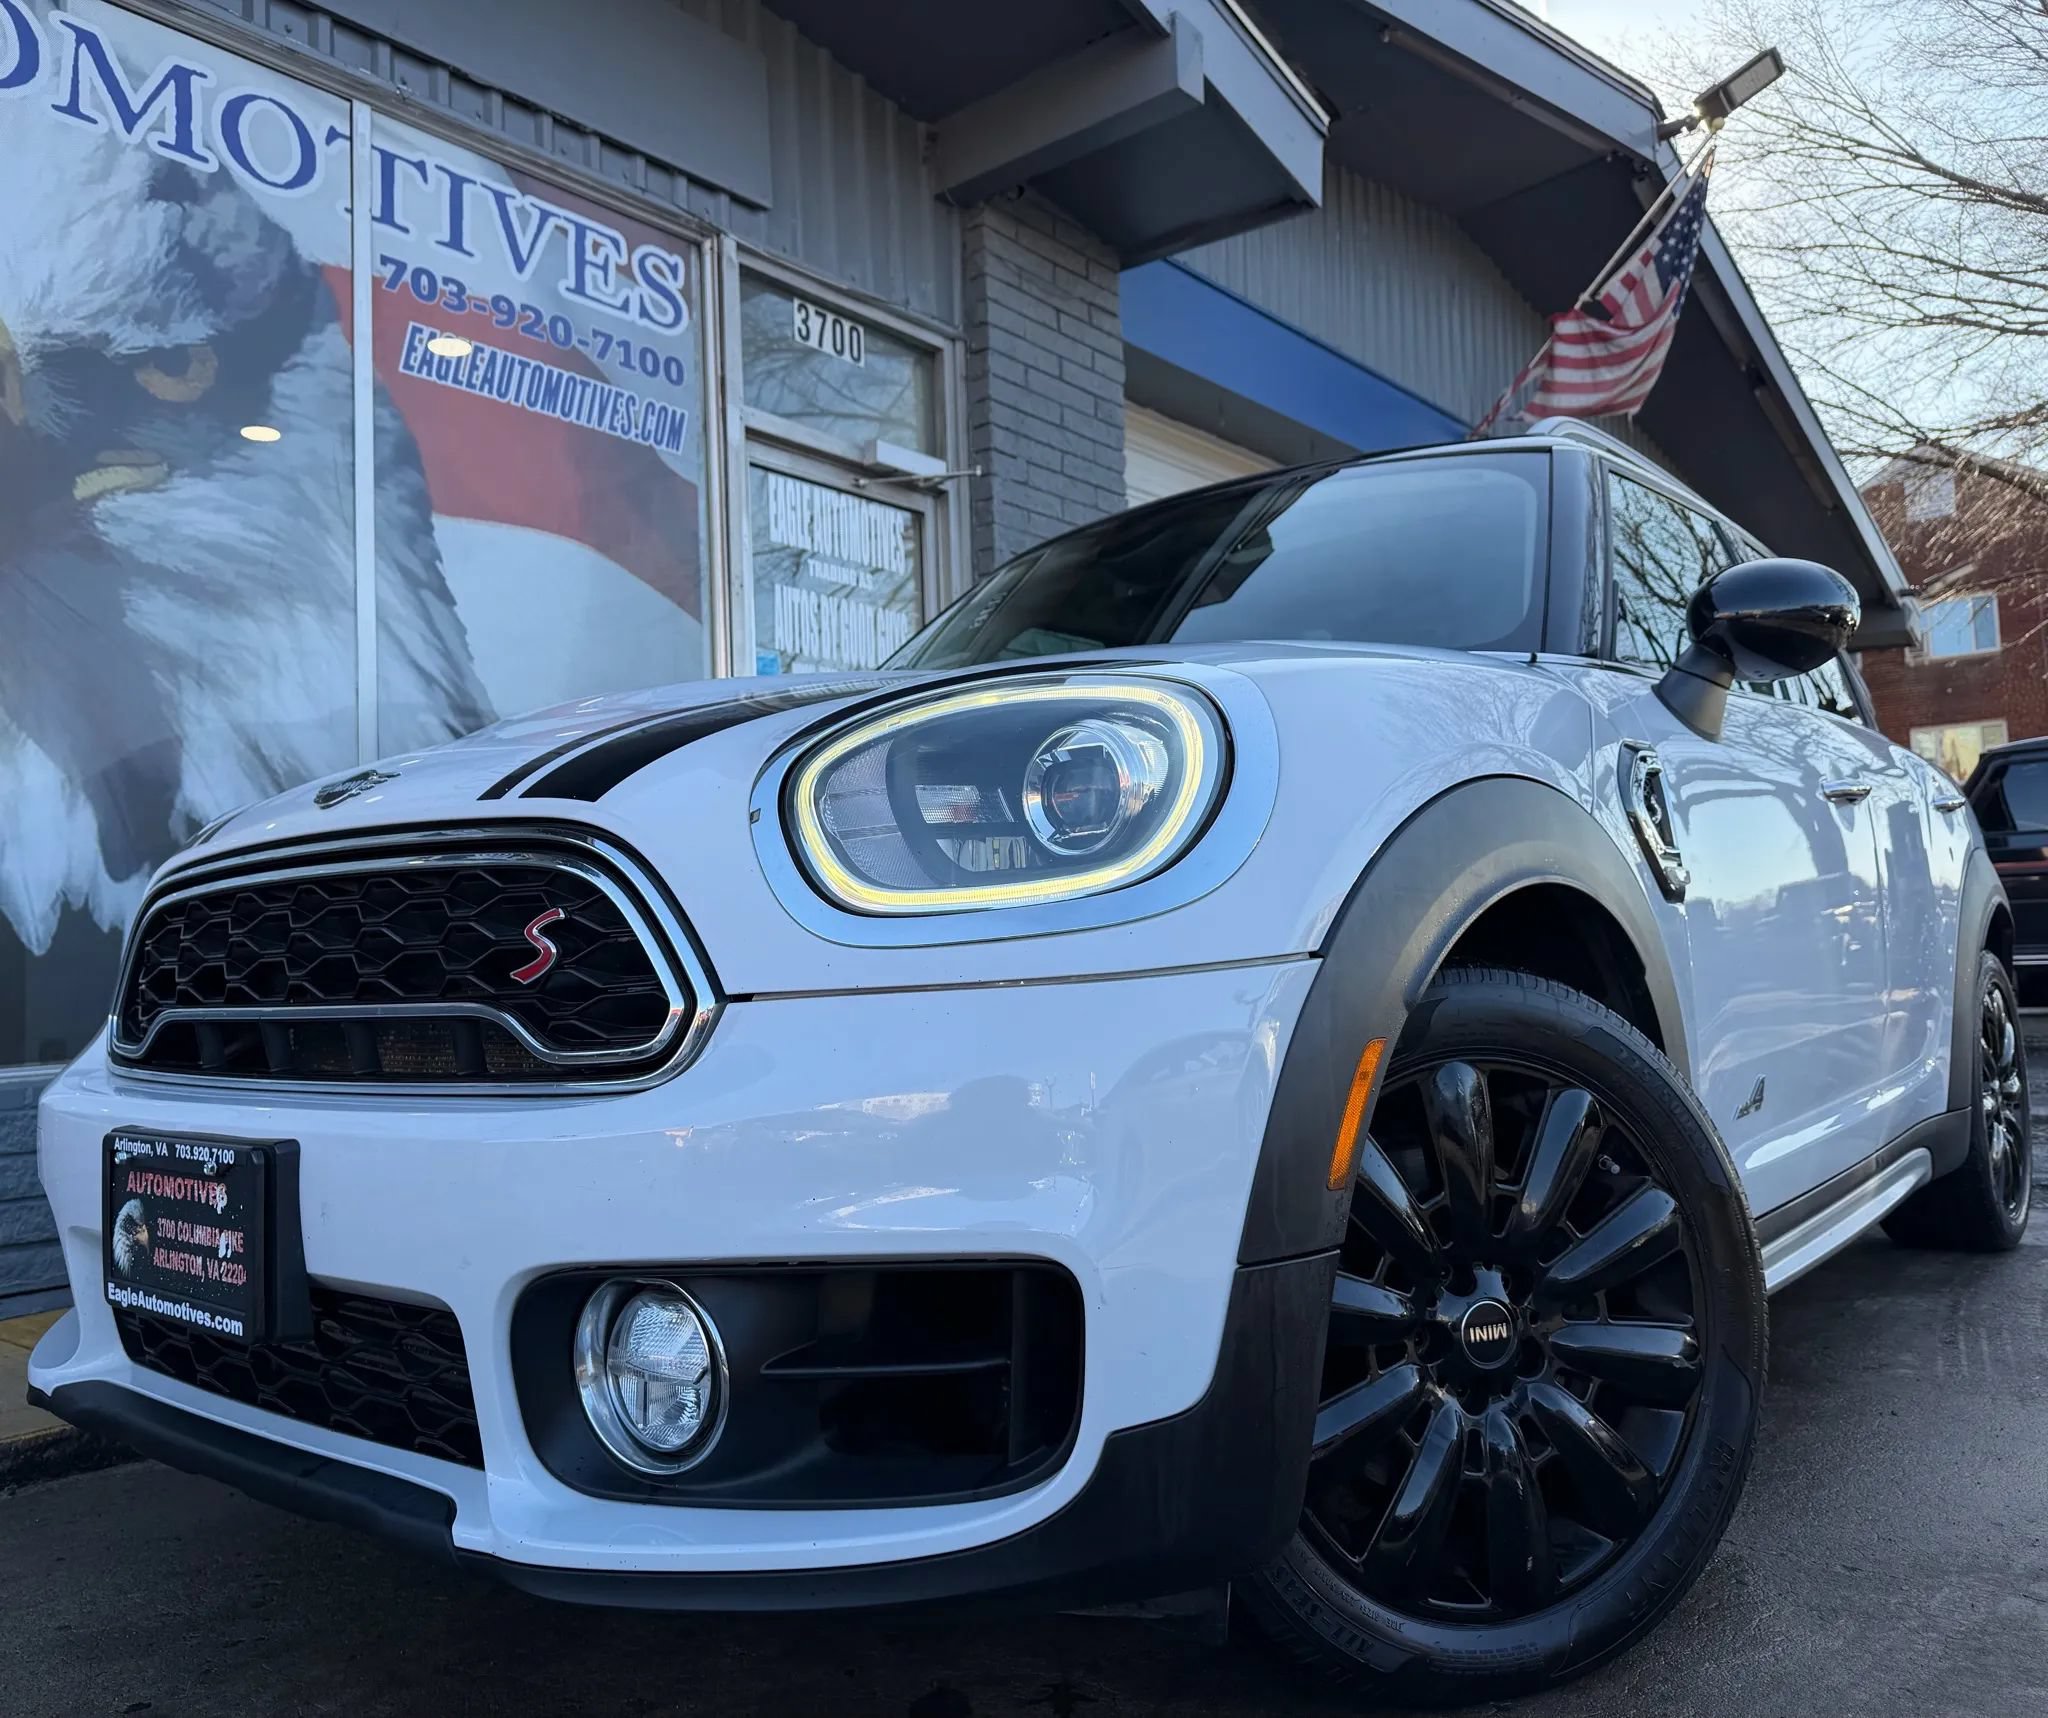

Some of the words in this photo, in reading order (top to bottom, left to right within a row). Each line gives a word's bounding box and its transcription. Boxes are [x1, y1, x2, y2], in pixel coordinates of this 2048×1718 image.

[379, 254, 685, 387] 703-920-7100
[797, 302, 861, 364] 3700
[400, 322, 687, 453] EAGLEAUTOMOTIVES.COM
[813, 487, 905, 576] AUTOMOTIVES
[775, 583, 819, 659] AUTOS
[510, 907, 565, 984] S
[113, 1137, 153, 1156] Arlington,
[155, 1142, 168, 1157] VA
[175, 1144, 235, 1165] 703.920.7100
[157, 1217, 176, 1240] 3700
[177, 1221, 220, 1248] COLUMBIA
[207, 1258, 220, 1281] VA
[107, 1282, 243, 1337] EagleAutomotives.com
[1469, 1322, 1508, 1344] MINI
